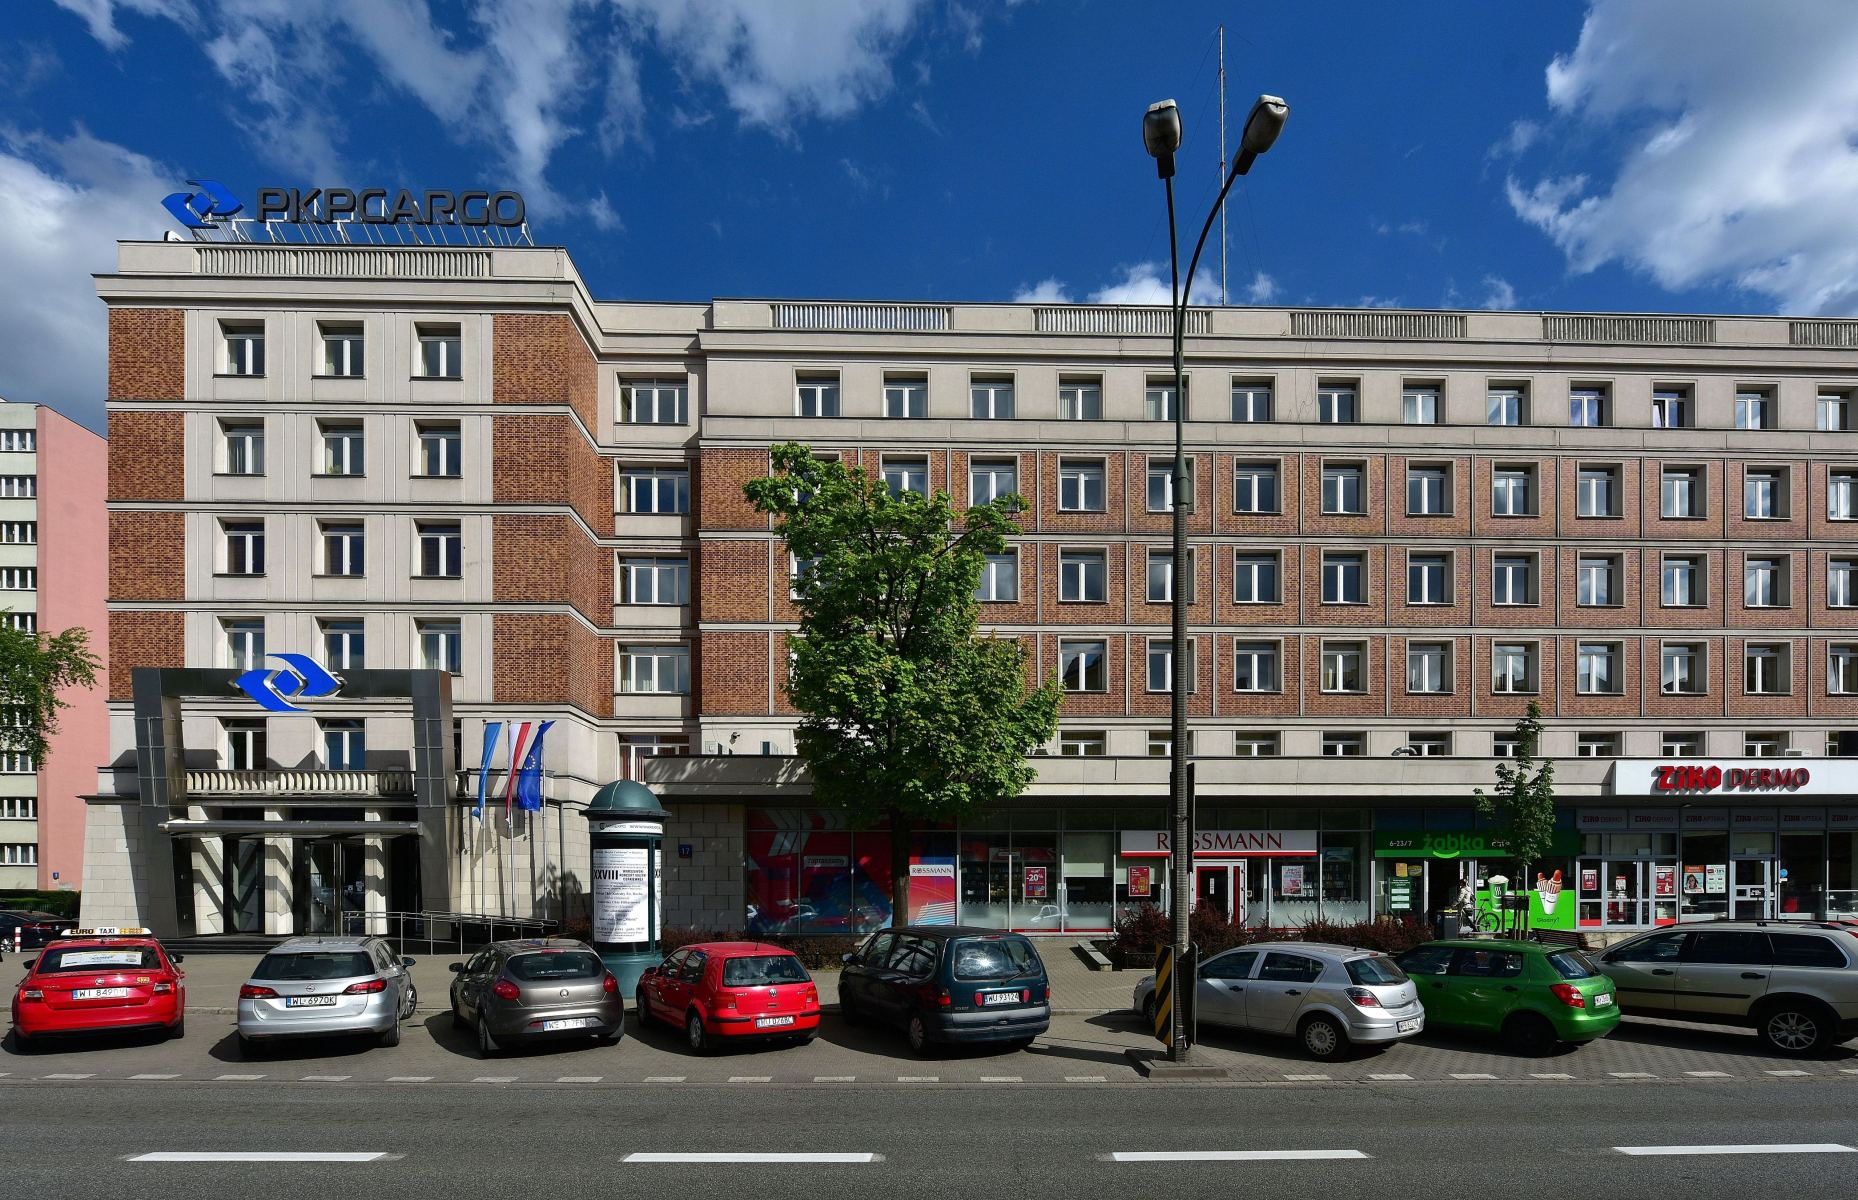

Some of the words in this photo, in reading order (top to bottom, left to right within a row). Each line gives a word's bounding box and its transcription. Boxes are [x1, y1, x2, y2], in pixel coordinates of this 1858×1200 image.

[1731, 767, 1811, 788] DERMO
[1157, 832, 1282, 850] RSMANN
[681, 847, 690, 855] 17
[79, 989, 91, 997] WI
